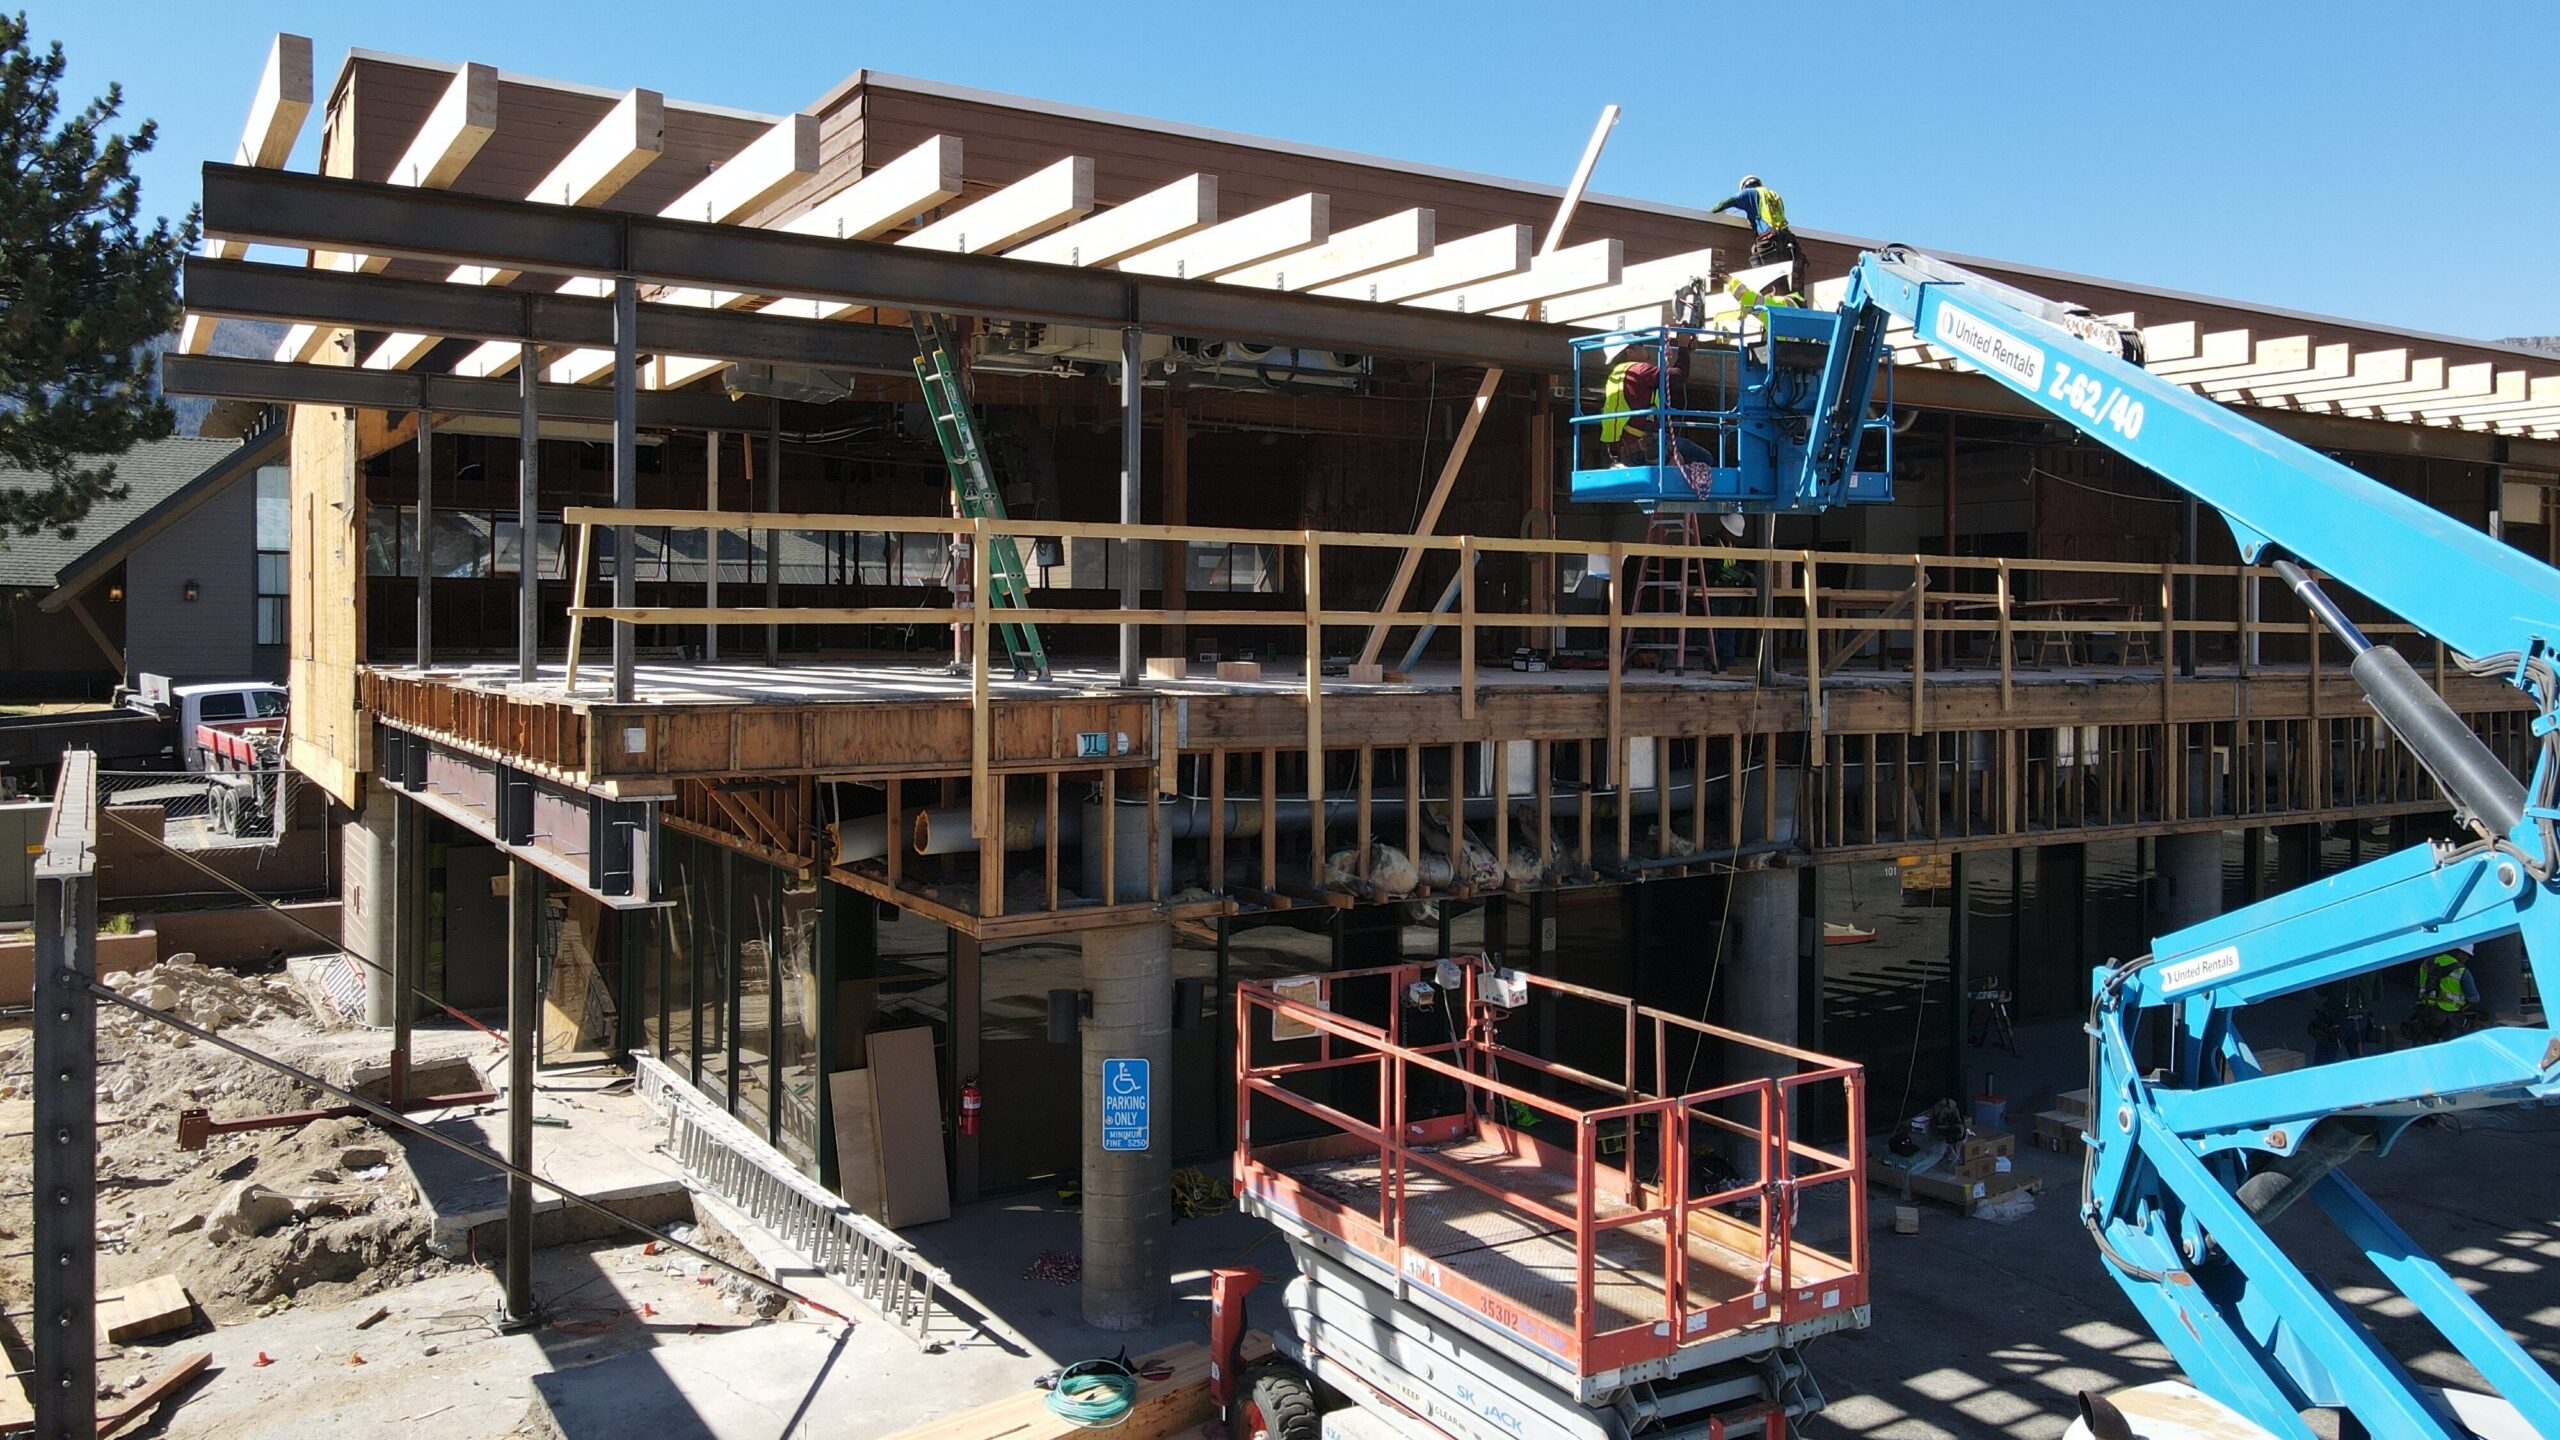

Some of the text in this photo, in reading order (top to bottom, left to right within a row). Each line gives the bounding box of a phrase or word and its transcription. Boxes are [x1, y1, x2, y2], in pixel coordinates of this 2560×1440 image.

[1956, 319, 2036, 379] United Rentals
[2048, 361, 2145, 440] Z-62/40
[1884, 866, 1897, 877] 101
[2174, 954, 2233, 982] United Rentals
[1106, 1096, 1145, 1110] PARKING
[1114, 1111, 1137, 1125] ONLY
[1106, 1139, 1121, 1147] FINE
[1480, 1296, 1519, 1331] 35302
[1401, 1386, 1459, 1426] KEEP CLEAR
